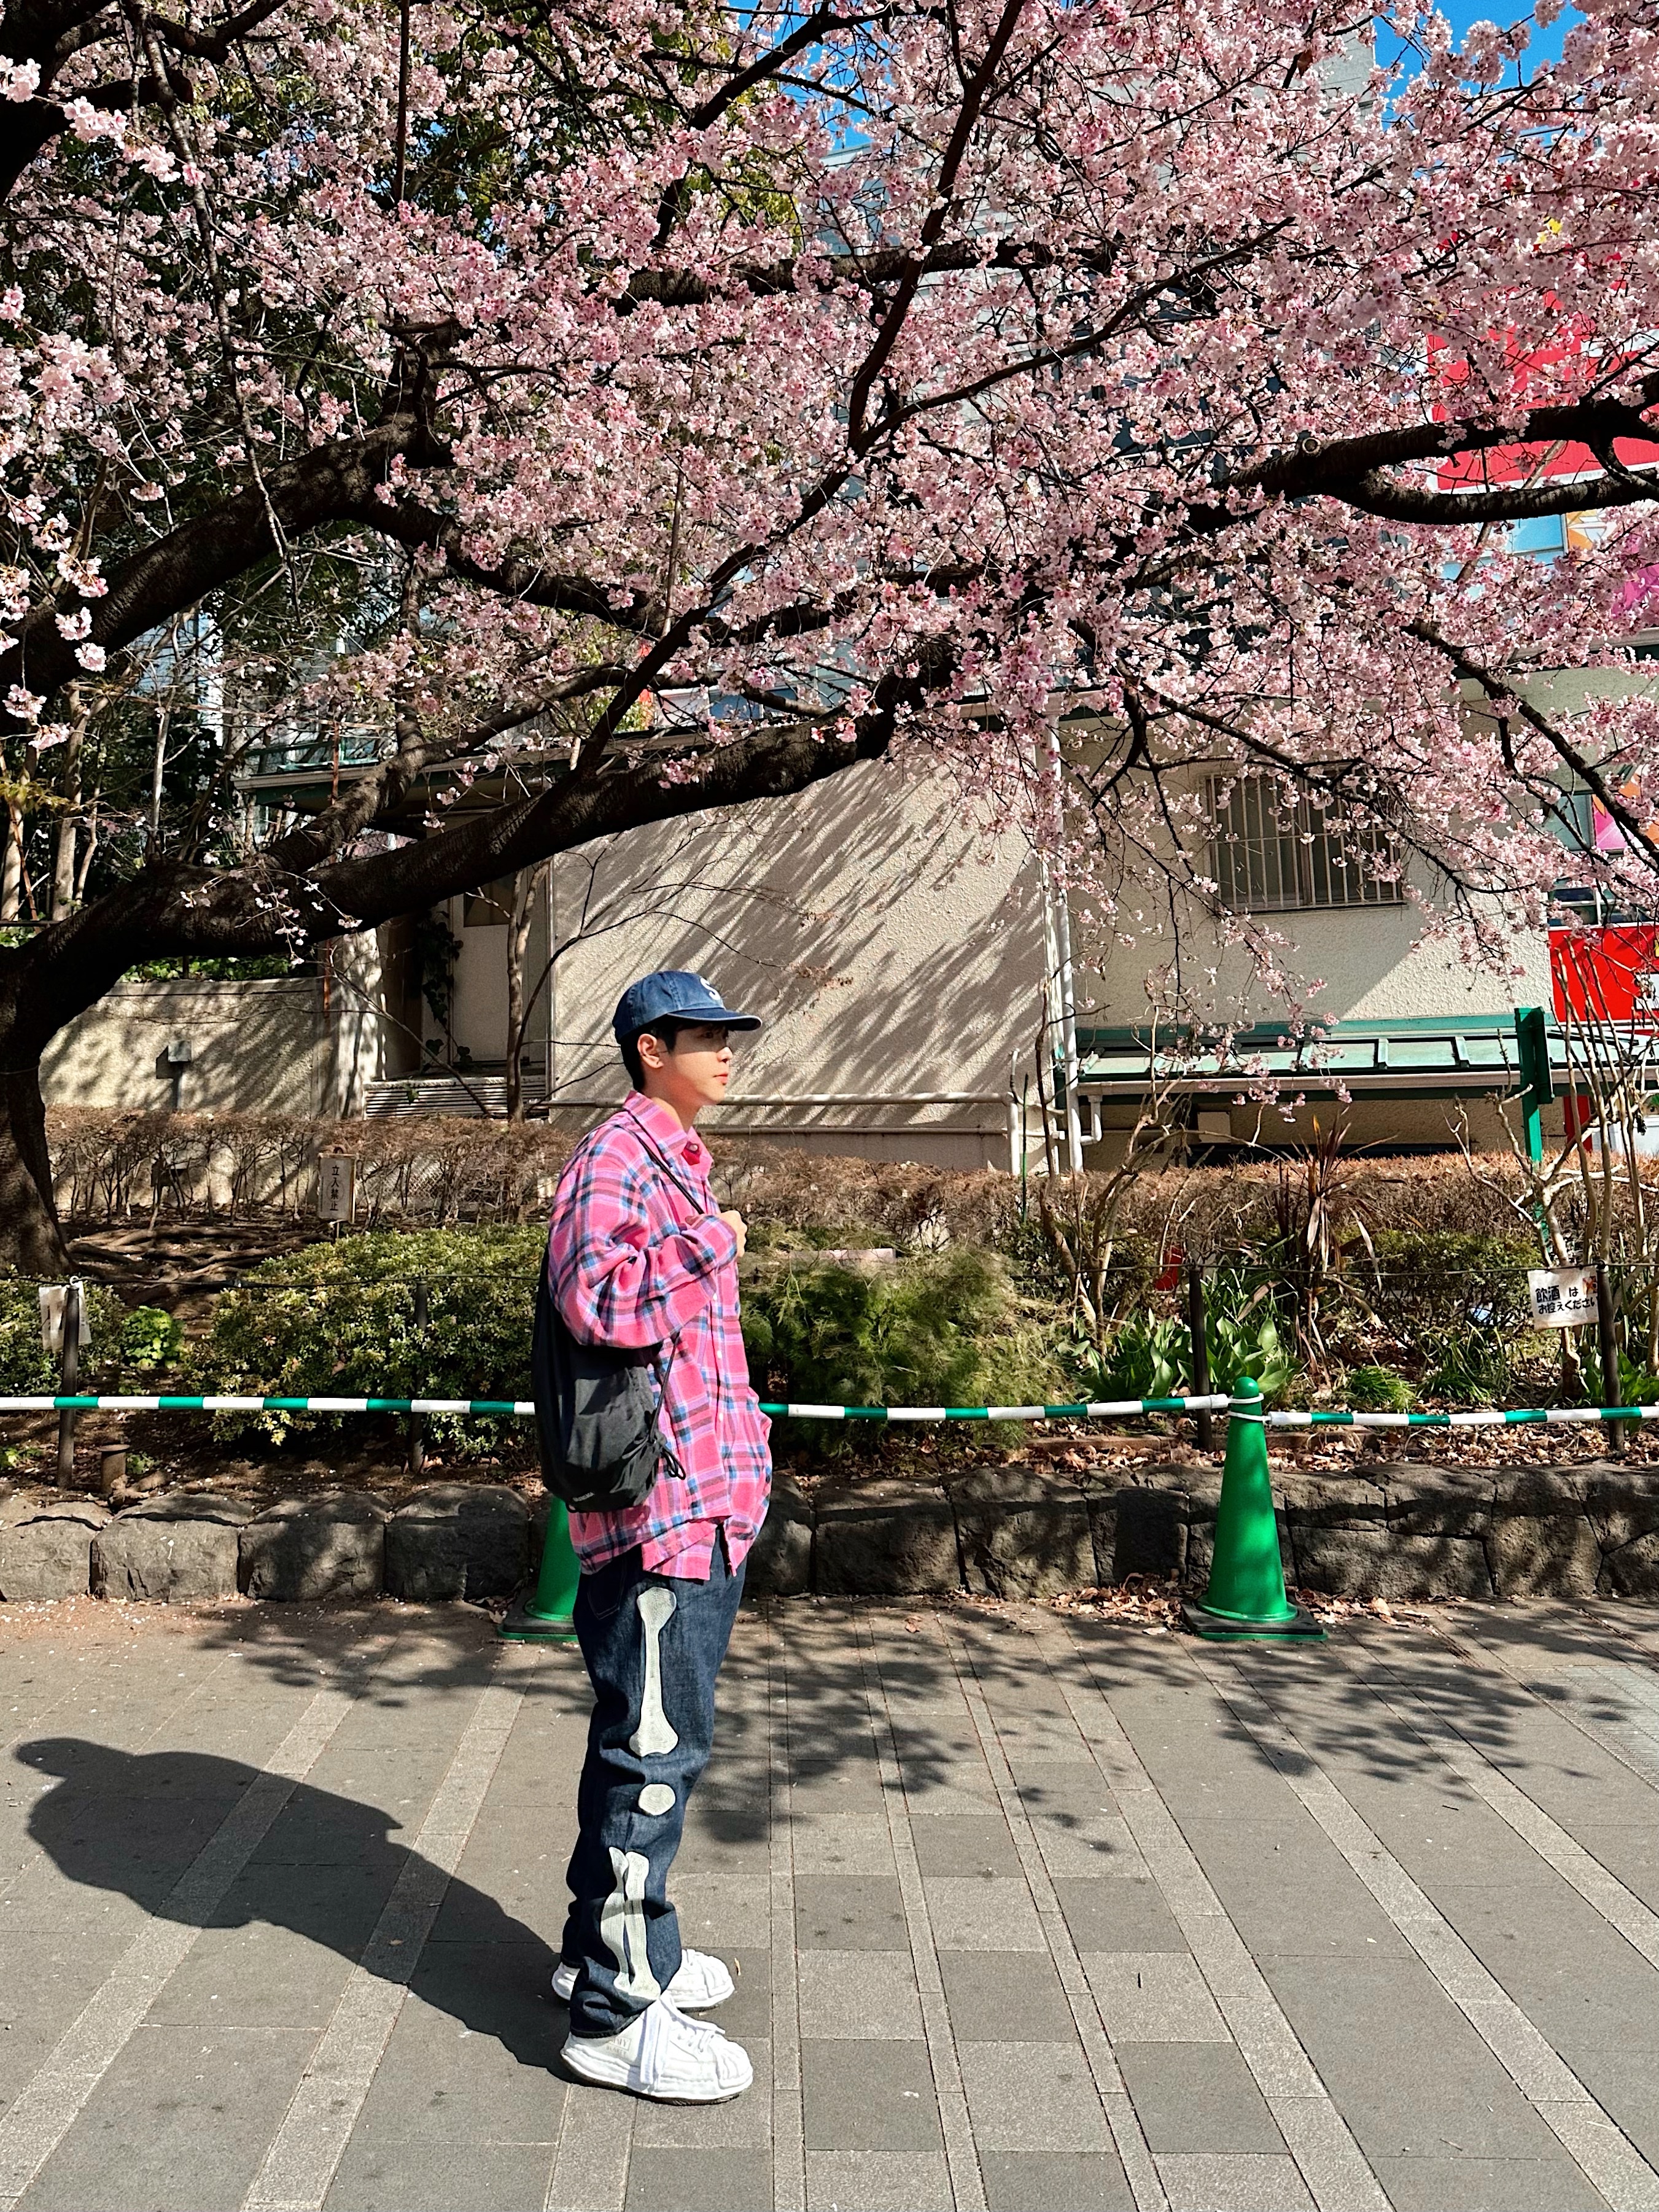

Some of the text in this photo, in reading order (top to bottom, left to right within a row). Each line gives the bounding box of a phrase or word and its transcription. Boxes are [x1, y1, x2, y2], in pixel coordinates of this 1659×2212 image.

[701, 977, 720, 1000] S
[330, 1165, 340, 1211] 立入禁止
